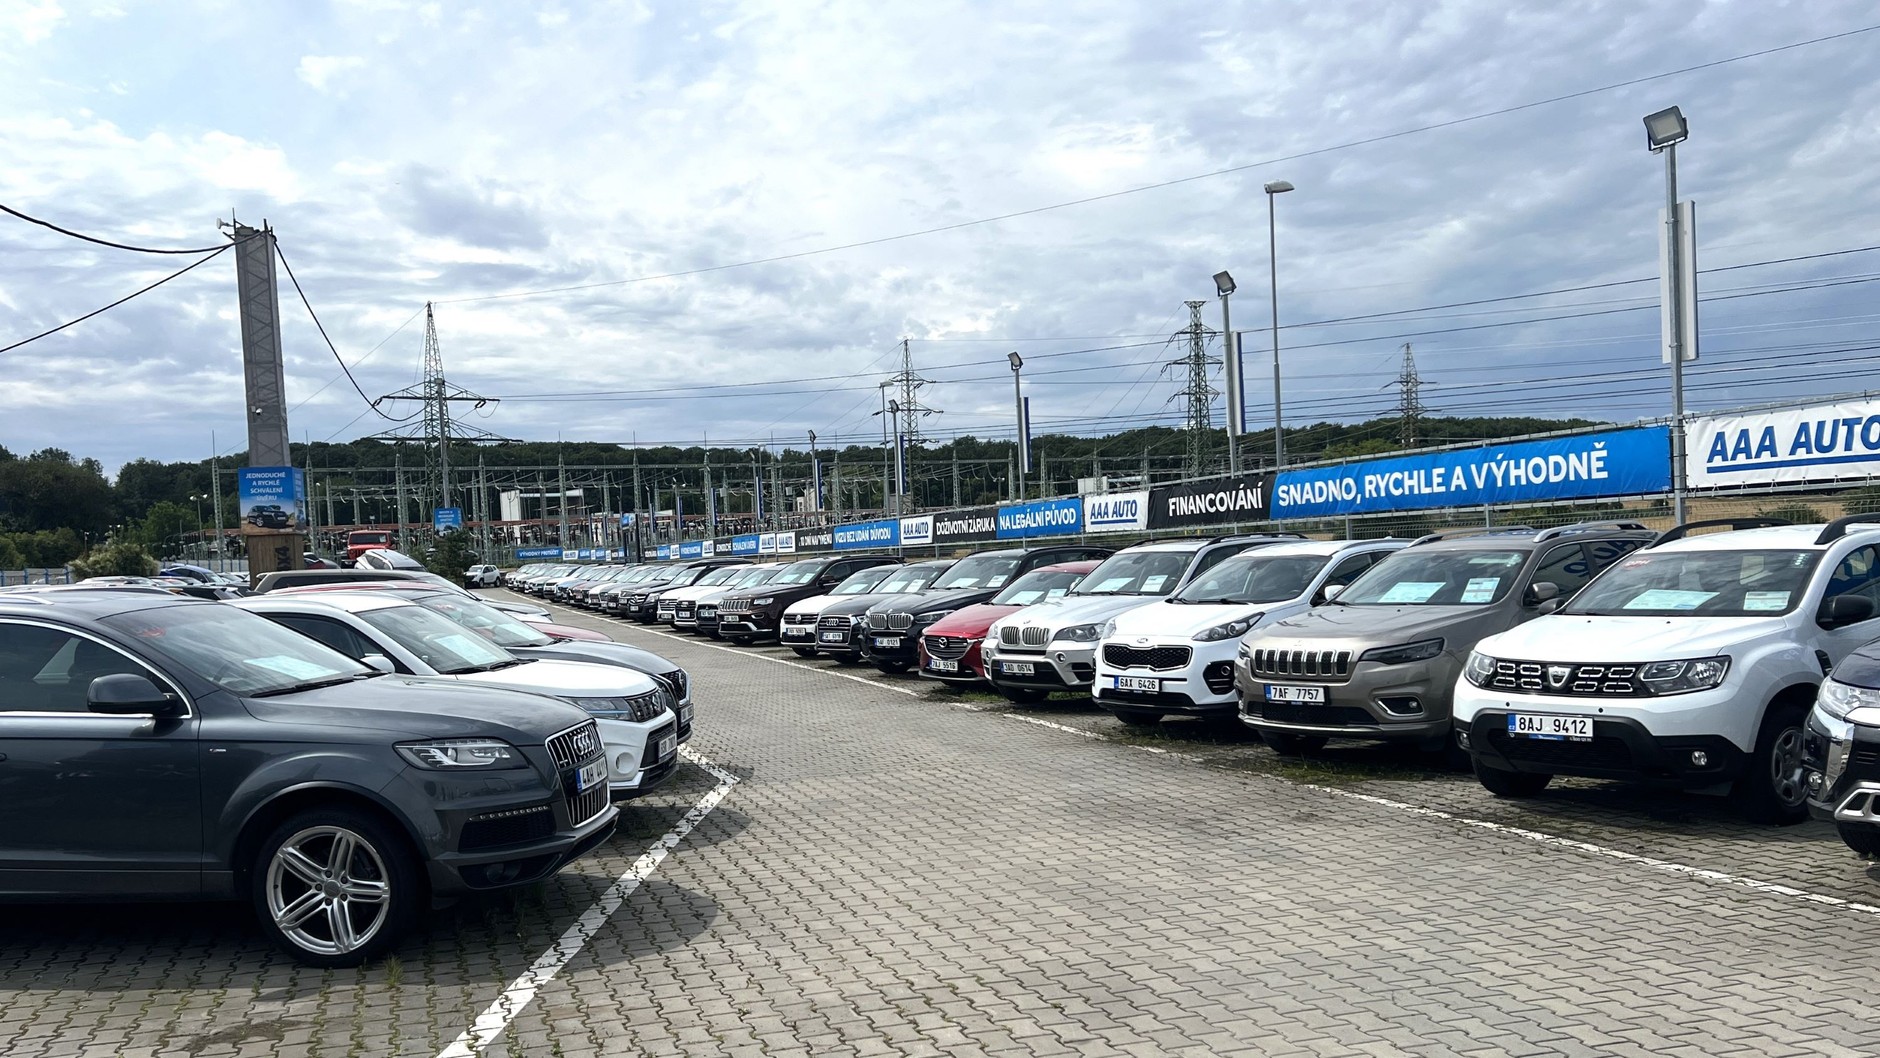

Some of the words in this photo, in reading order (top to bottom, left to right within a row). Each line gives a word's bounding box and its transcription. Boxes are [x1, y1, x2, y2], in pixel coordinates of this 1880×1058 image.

[1706, 425, 1779, 464] AAA
[1788, 414, 1880, 456] AUTO
[1277, 477, 1362, 507] SNADNO,
[1364, 467, 1446, 499] RYCHLE
[1450, 465, 1468, 492] A
[1470, 441, 1609, 490] VÝHODNĚ
[1168, 481, 1263, 517] FINANCOVÁNÍ
[999, 515, 1012, 530] NA
[1011, 506, 1045, 529] LEGÁLNÍ
[1045, 503, 1076, 526] PŮVOD
[1090, 502, 1109, 520] AAA
[1111, 499, 1138, 518] AUTO
[903, 524, 914, 535] AAA
[914, 521, 929, 534] AUTO
[936, 515, 969, 535] DOŽIVOTNÍ
[968, 515, 996, 534] ZÁRUKA
[1120, 678, 1133, 688] 6AX
[1138, 679, 1156, 690] 6426
[1272, 687, 1289, 699] 7AF
[1295, 688, 1319, 700] 7757
[1519, 717, 1543, 732] 8AJ
[1553, 718, 1587, 734] 9412
